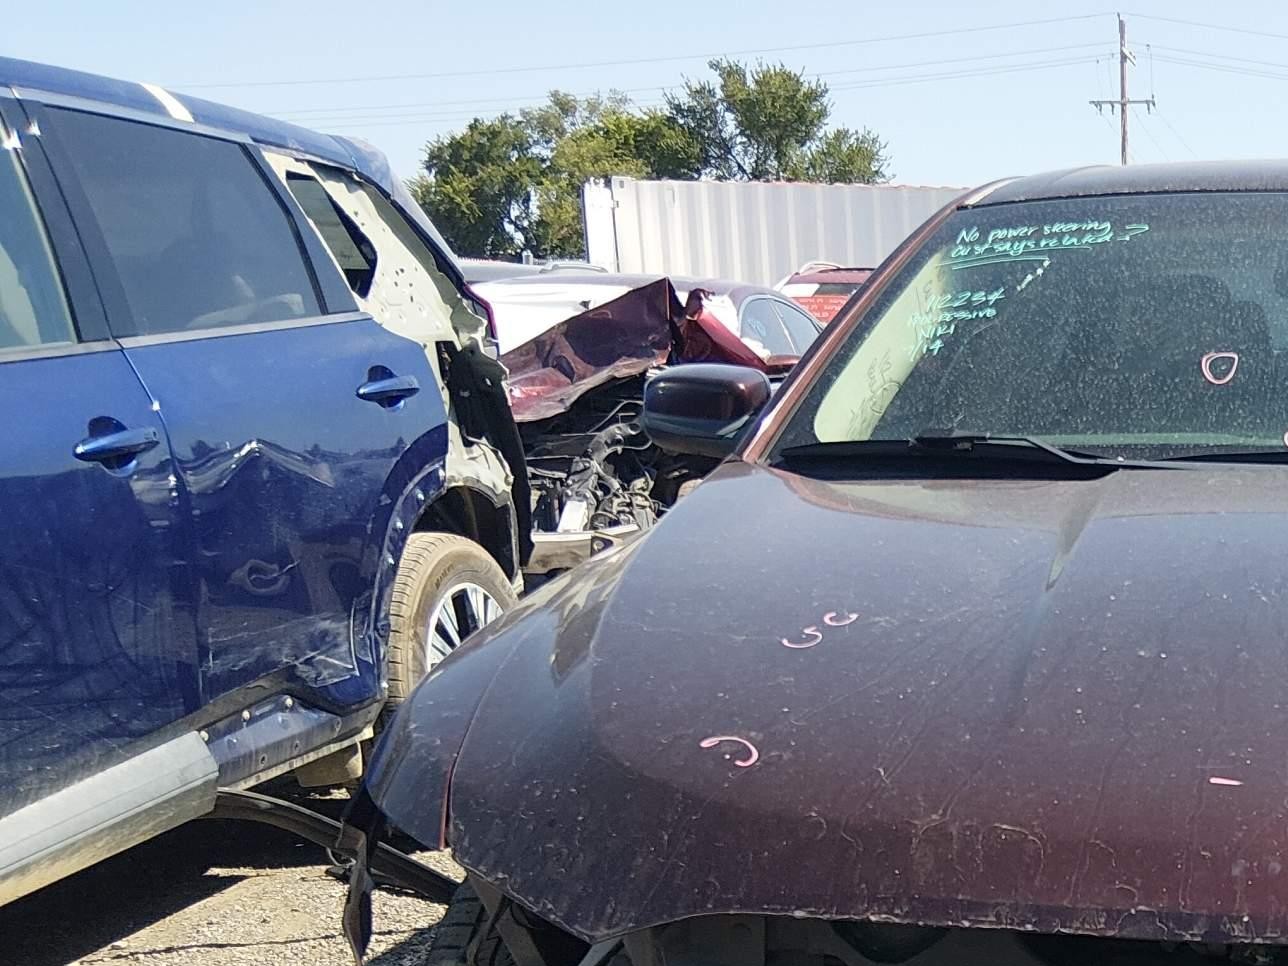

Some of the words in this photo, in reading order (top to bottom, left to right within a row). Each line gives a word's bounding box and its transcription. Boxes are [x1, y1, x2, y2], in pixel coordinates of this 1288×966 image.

[956, 227, 980, 244] No
[988, 225, 1036, 245] power
[1043, 219, 1112, 236] steering
